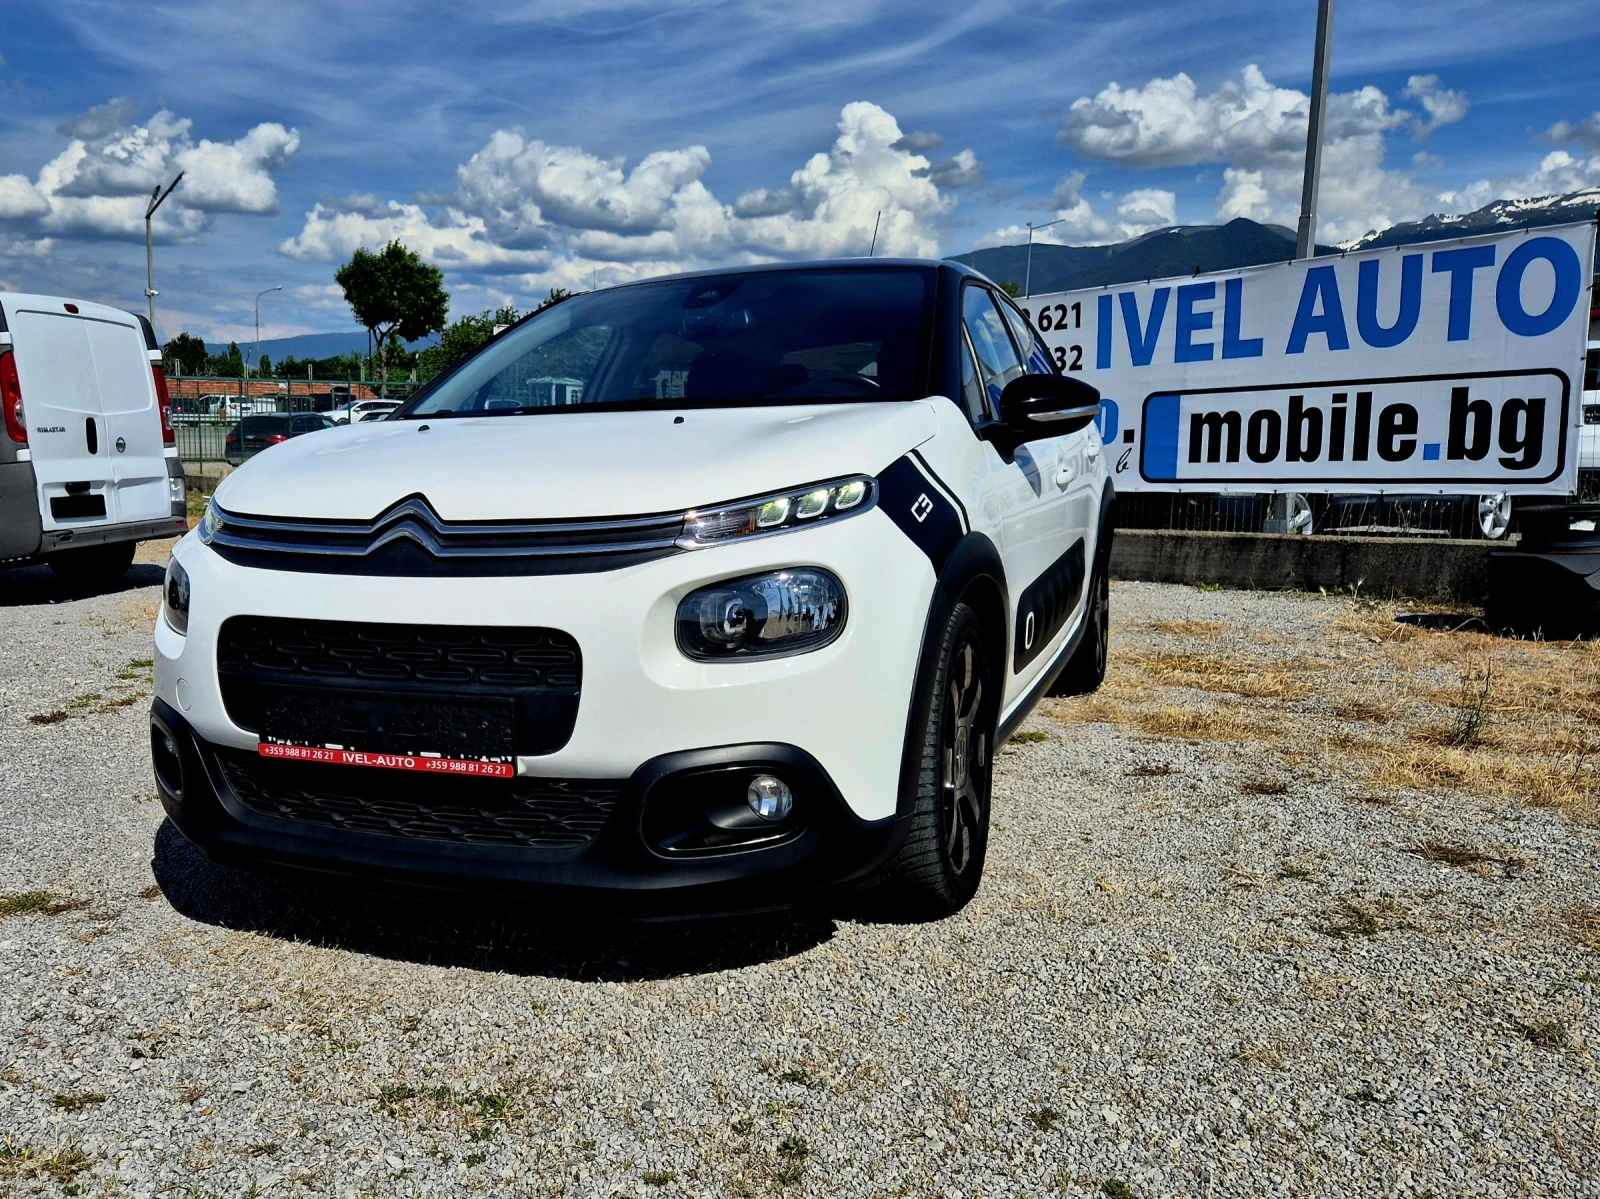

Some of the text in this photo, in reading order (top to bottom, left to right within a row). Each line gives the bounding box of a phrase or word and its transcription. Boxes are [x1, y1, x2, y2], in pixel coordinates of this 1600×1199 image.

[1037, 301, 1082, 333] 621
[1096, 236, 1582, 369] IVEL AUTO
[1048, 344, 1083, 373] 32
[1187, 385, 1547, 471] mobile.bg
[910, 492, 934, 523] C3
[264, 746, 507, 775] +359 988 81 26 21 IVEL-AUTO +359 988 81 26 21
